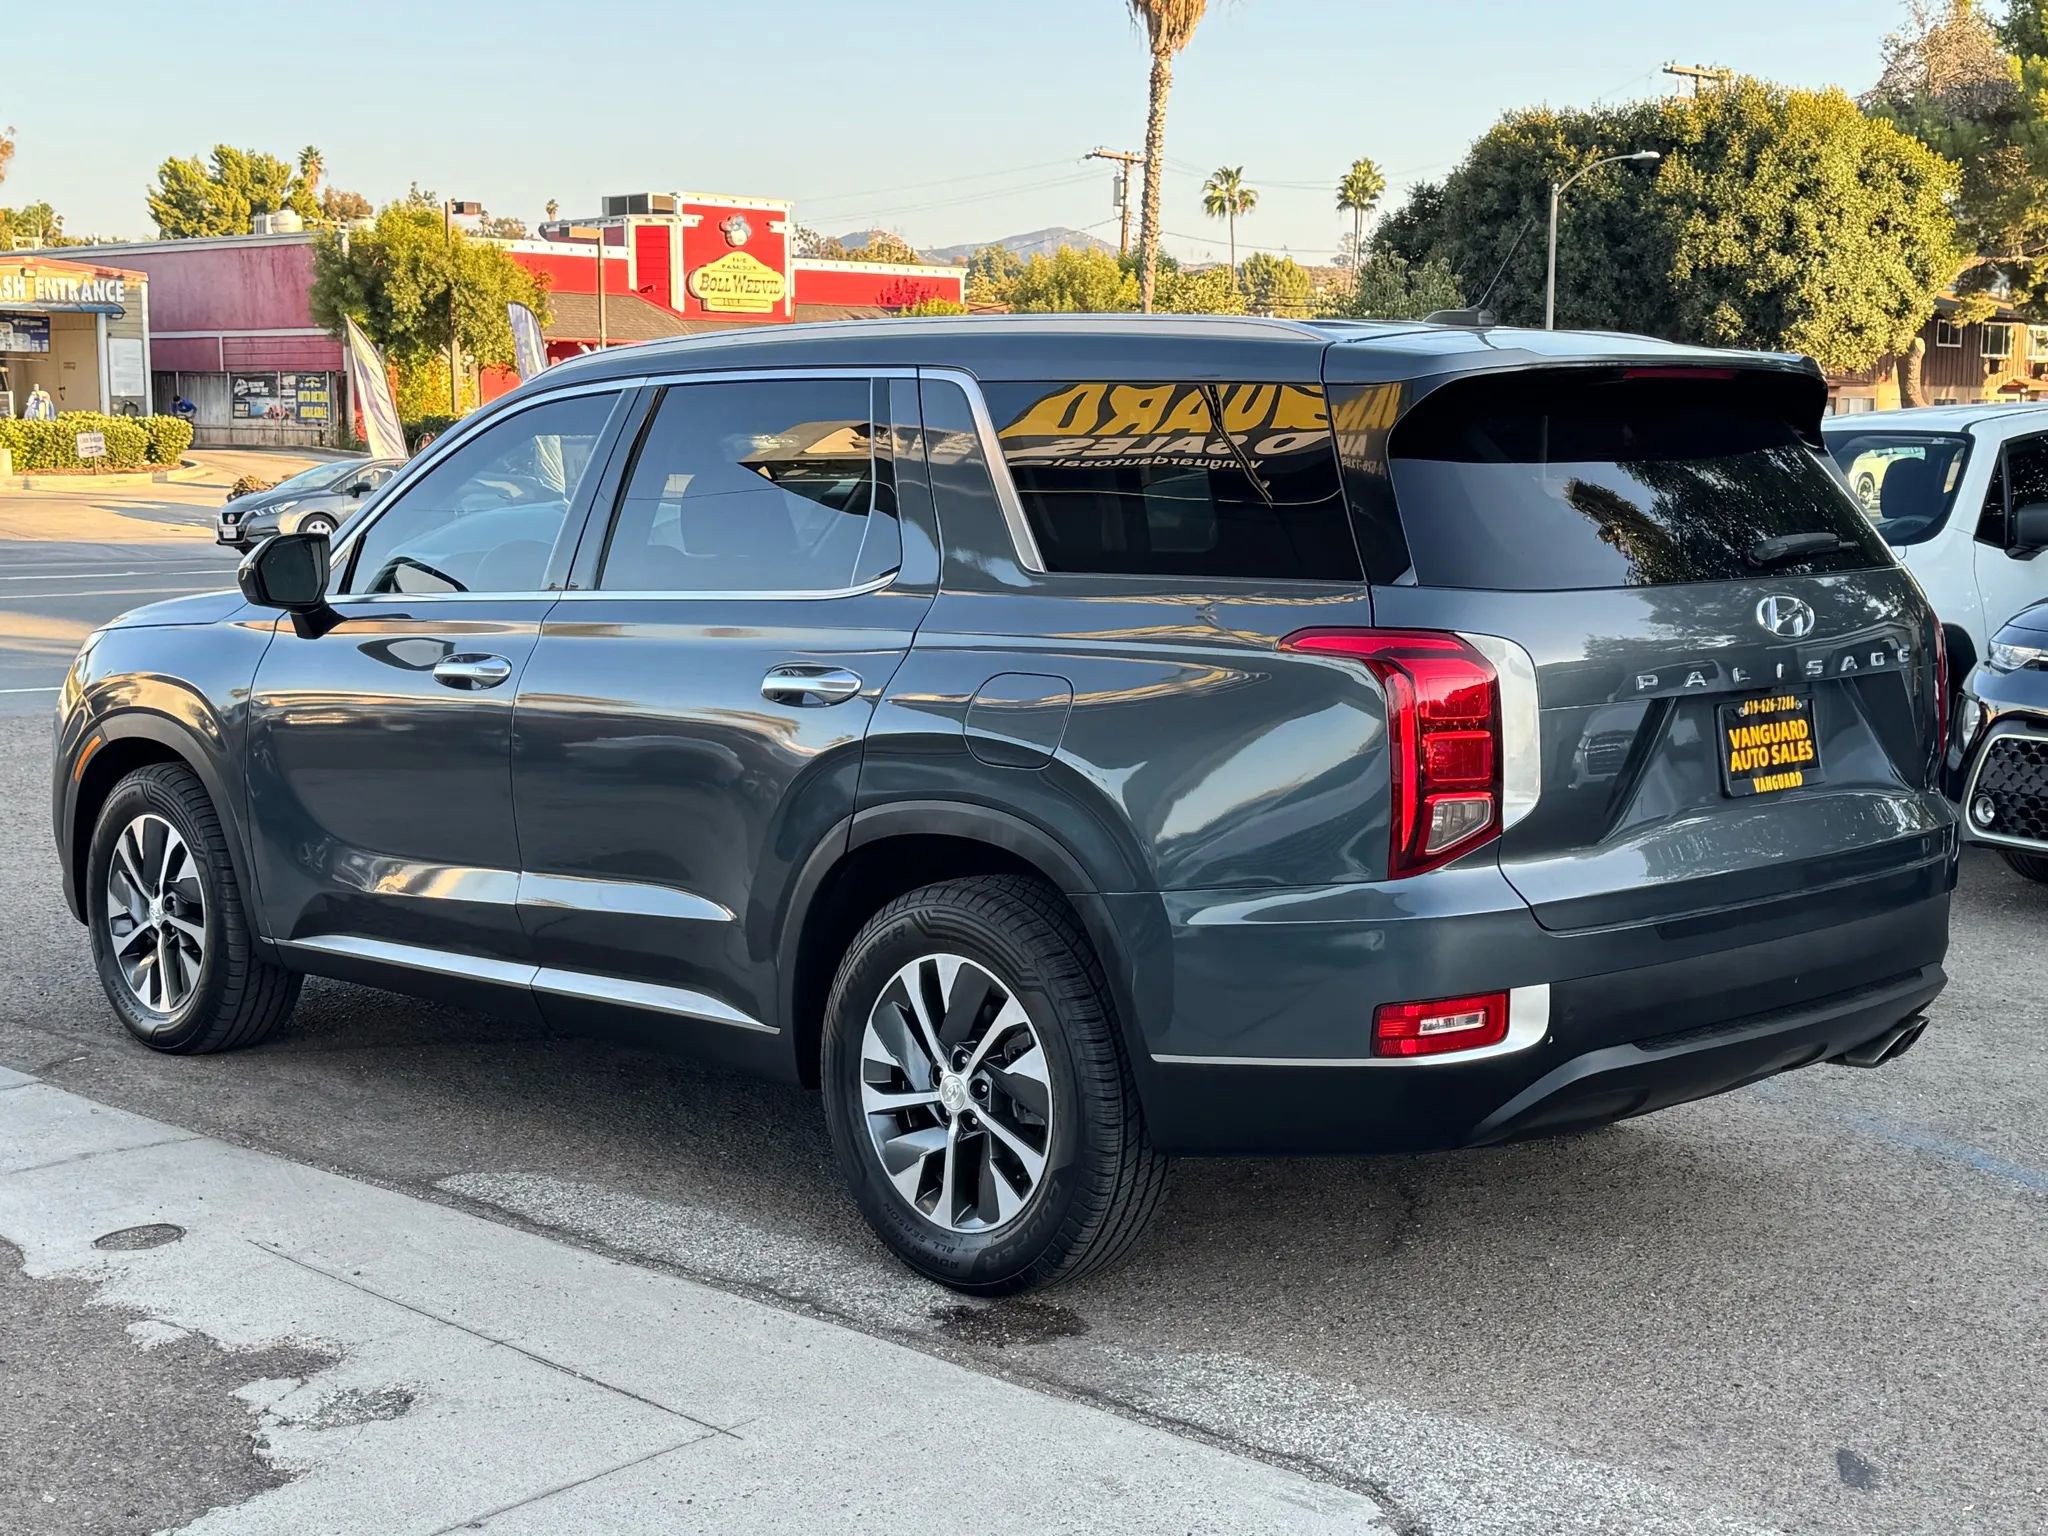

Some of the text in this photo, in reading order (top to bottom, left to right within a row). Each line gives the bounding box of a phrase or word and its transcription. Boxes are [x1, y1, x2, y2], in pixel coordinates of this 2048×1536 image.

[35, 277, 125, 302] ENTRANCE
[699, 273, 780, 294] BOLL WEEVIL
[1635, 645, 1911, 691] PALISADE
[1729, 719, 1808, 749] VANGUARD
[1731, 740, 1813, 772] AUTO SALES
[1753, 771, 1803, 793] VANGUARD
